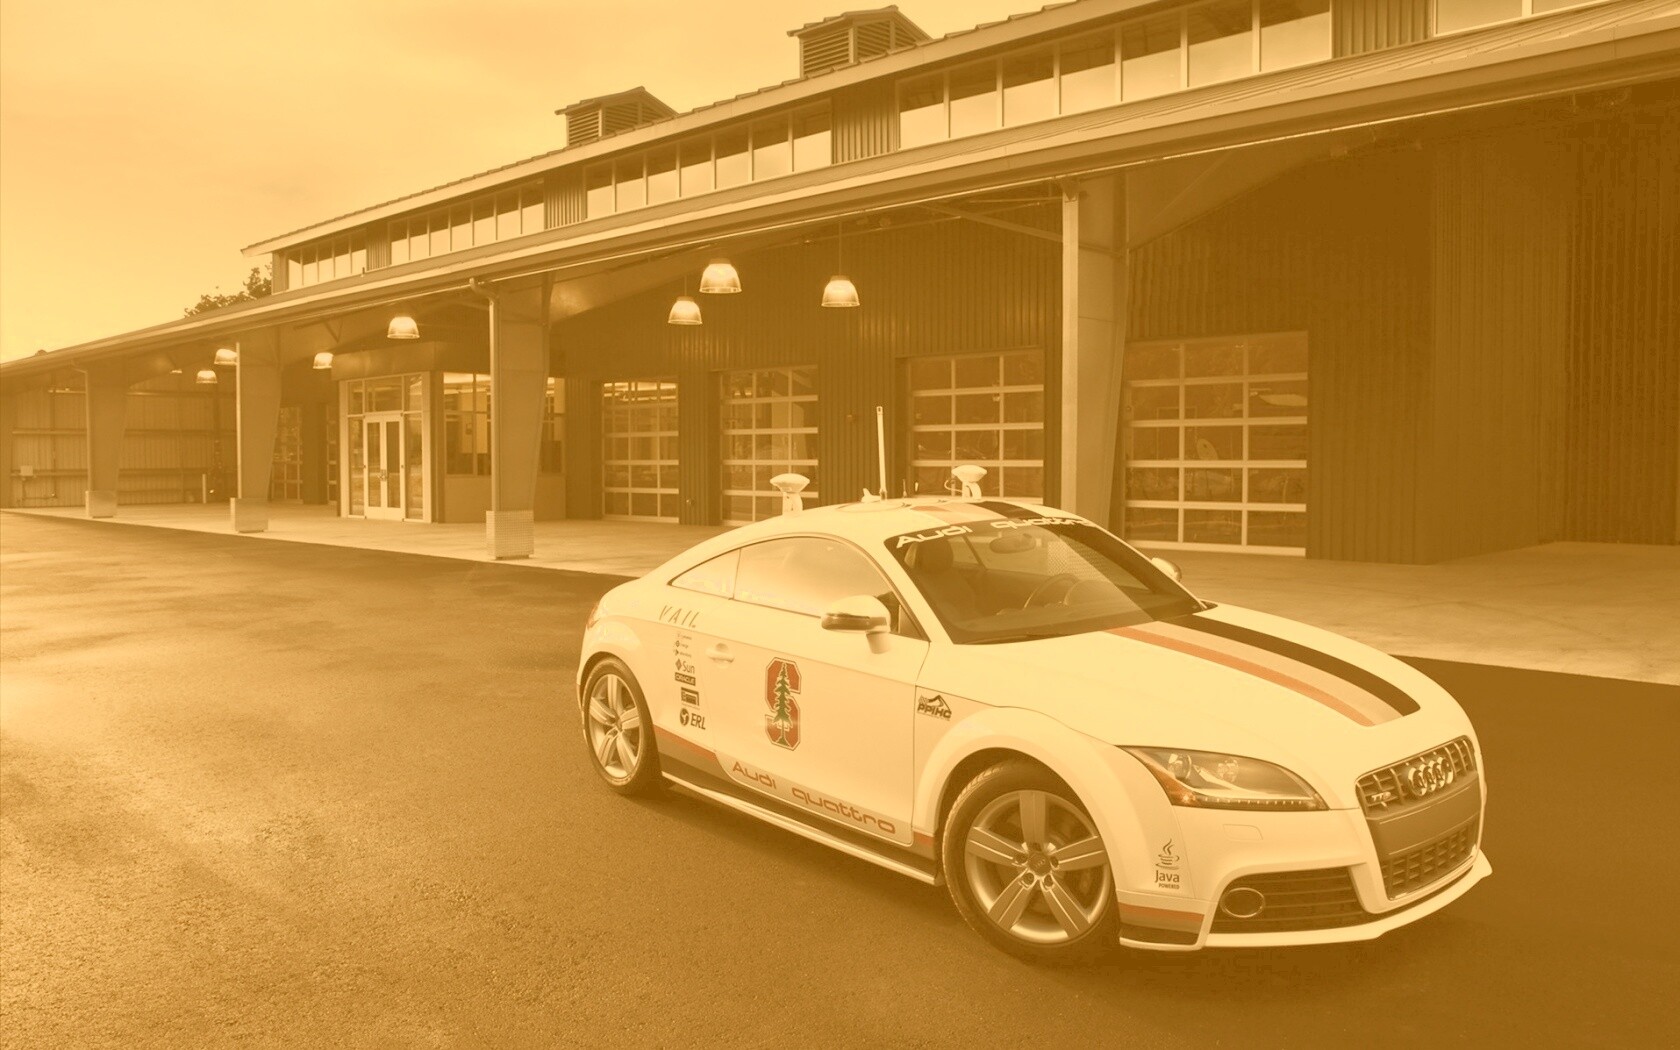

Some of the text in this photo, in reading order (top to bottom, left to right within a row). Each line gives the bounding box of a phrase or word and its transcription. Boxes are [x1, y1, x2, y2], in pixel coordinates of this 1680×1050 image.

[896, 525, 974, 549] Audi
[659, 605, 699, 628] VAIL
[682, 660, 696, 675] Sun
[917, 702, 952, 719] PPIHC
[690, 712, 707, 730] ERL
[732, 761, 896, 835] Audi quattro
[1154, 869, 1180, 883] Java
